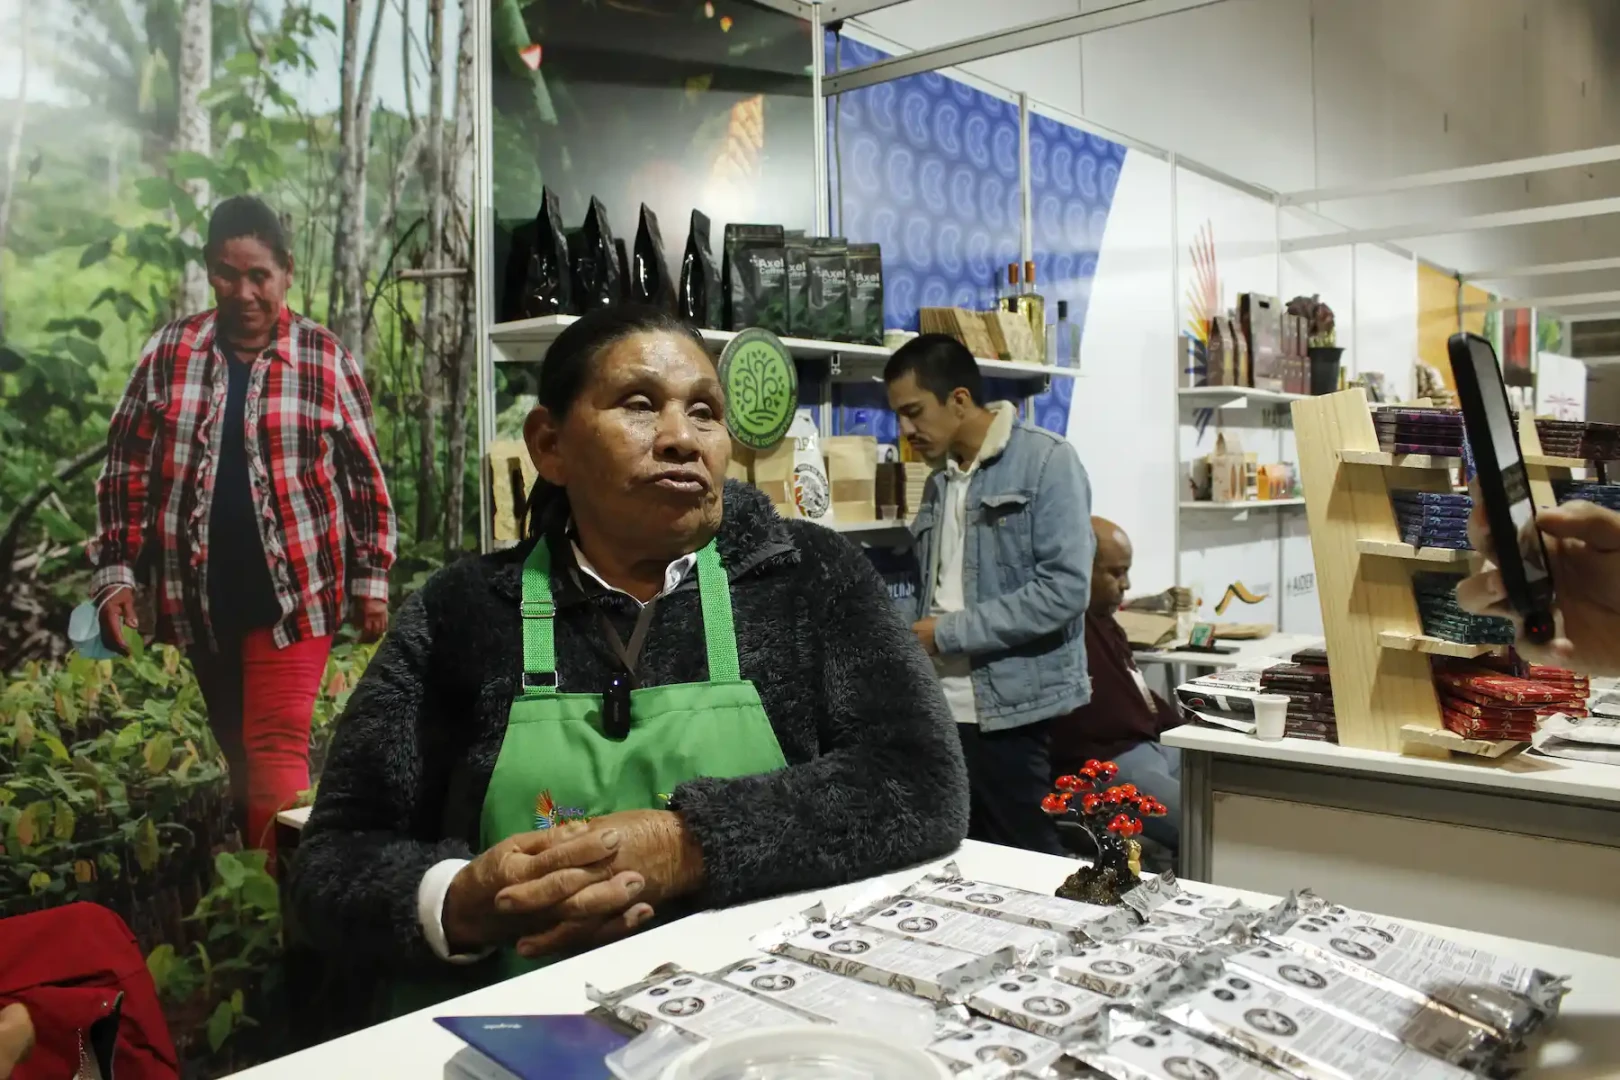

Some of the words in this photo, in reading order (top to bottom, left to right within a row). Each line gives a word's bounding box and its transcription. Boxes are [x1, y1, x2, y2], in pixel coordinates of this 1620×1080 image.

[758, 257, 785, 268] Axel
[821, 269, 847, 279] Axel
[855, 272, 880, 282] Axel
